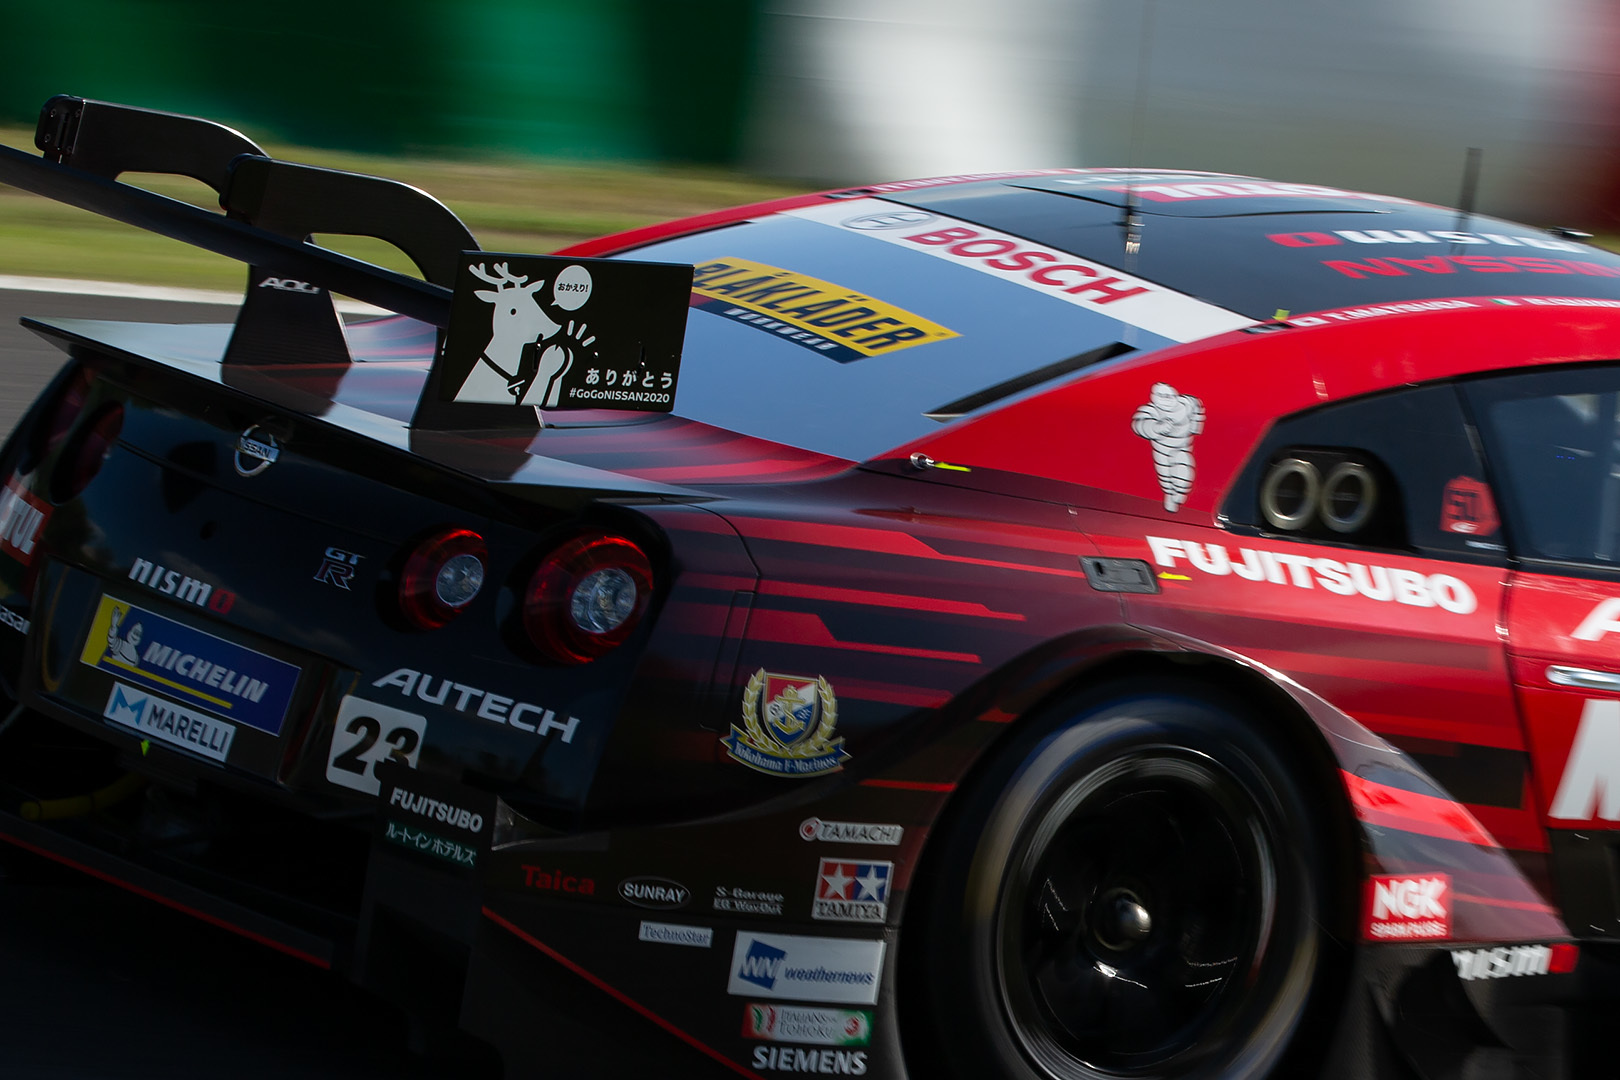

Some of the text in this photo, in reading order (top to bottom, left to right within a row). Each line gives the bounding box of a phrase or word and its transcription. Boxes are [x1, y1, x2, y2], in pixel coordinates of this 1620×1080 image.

[900, 226, 1151, 305] BOSCH
[557, 283, 589, 293] おかえり!
[585, 367, 673, 389] ありがとう
[569, 387, 670, 403] #GoGoNISSAN2020
[324, 546, 366, 564] GT
[128, 557, 236, 615] nismo
[313, 559, 355, 591] R
[1146, 535, 1477, 615] FUJITSUBO
[142, 640, 270, 704] MICHELIN
[371, 667, 581, 744] AUTECH
[147, 703, 230, 753] MARELLI
[333, 716, 420, 775] 23
[389, 786, 484, 833] FUJITSUBO
[822, 822, 897, 842] TAMACHI
[521, 864, 595, 896] Taica
[623, 881, 686, 904] SUNRAY
[816, 902, 882, 918] TAMIYA
[1372, 878, 1448, 920] NGK
[643, 925, 709, 944] TechnoStar
[785, 965, 874, 985] weathernews
[752, 1045, 868, 1076] SIEMENS
